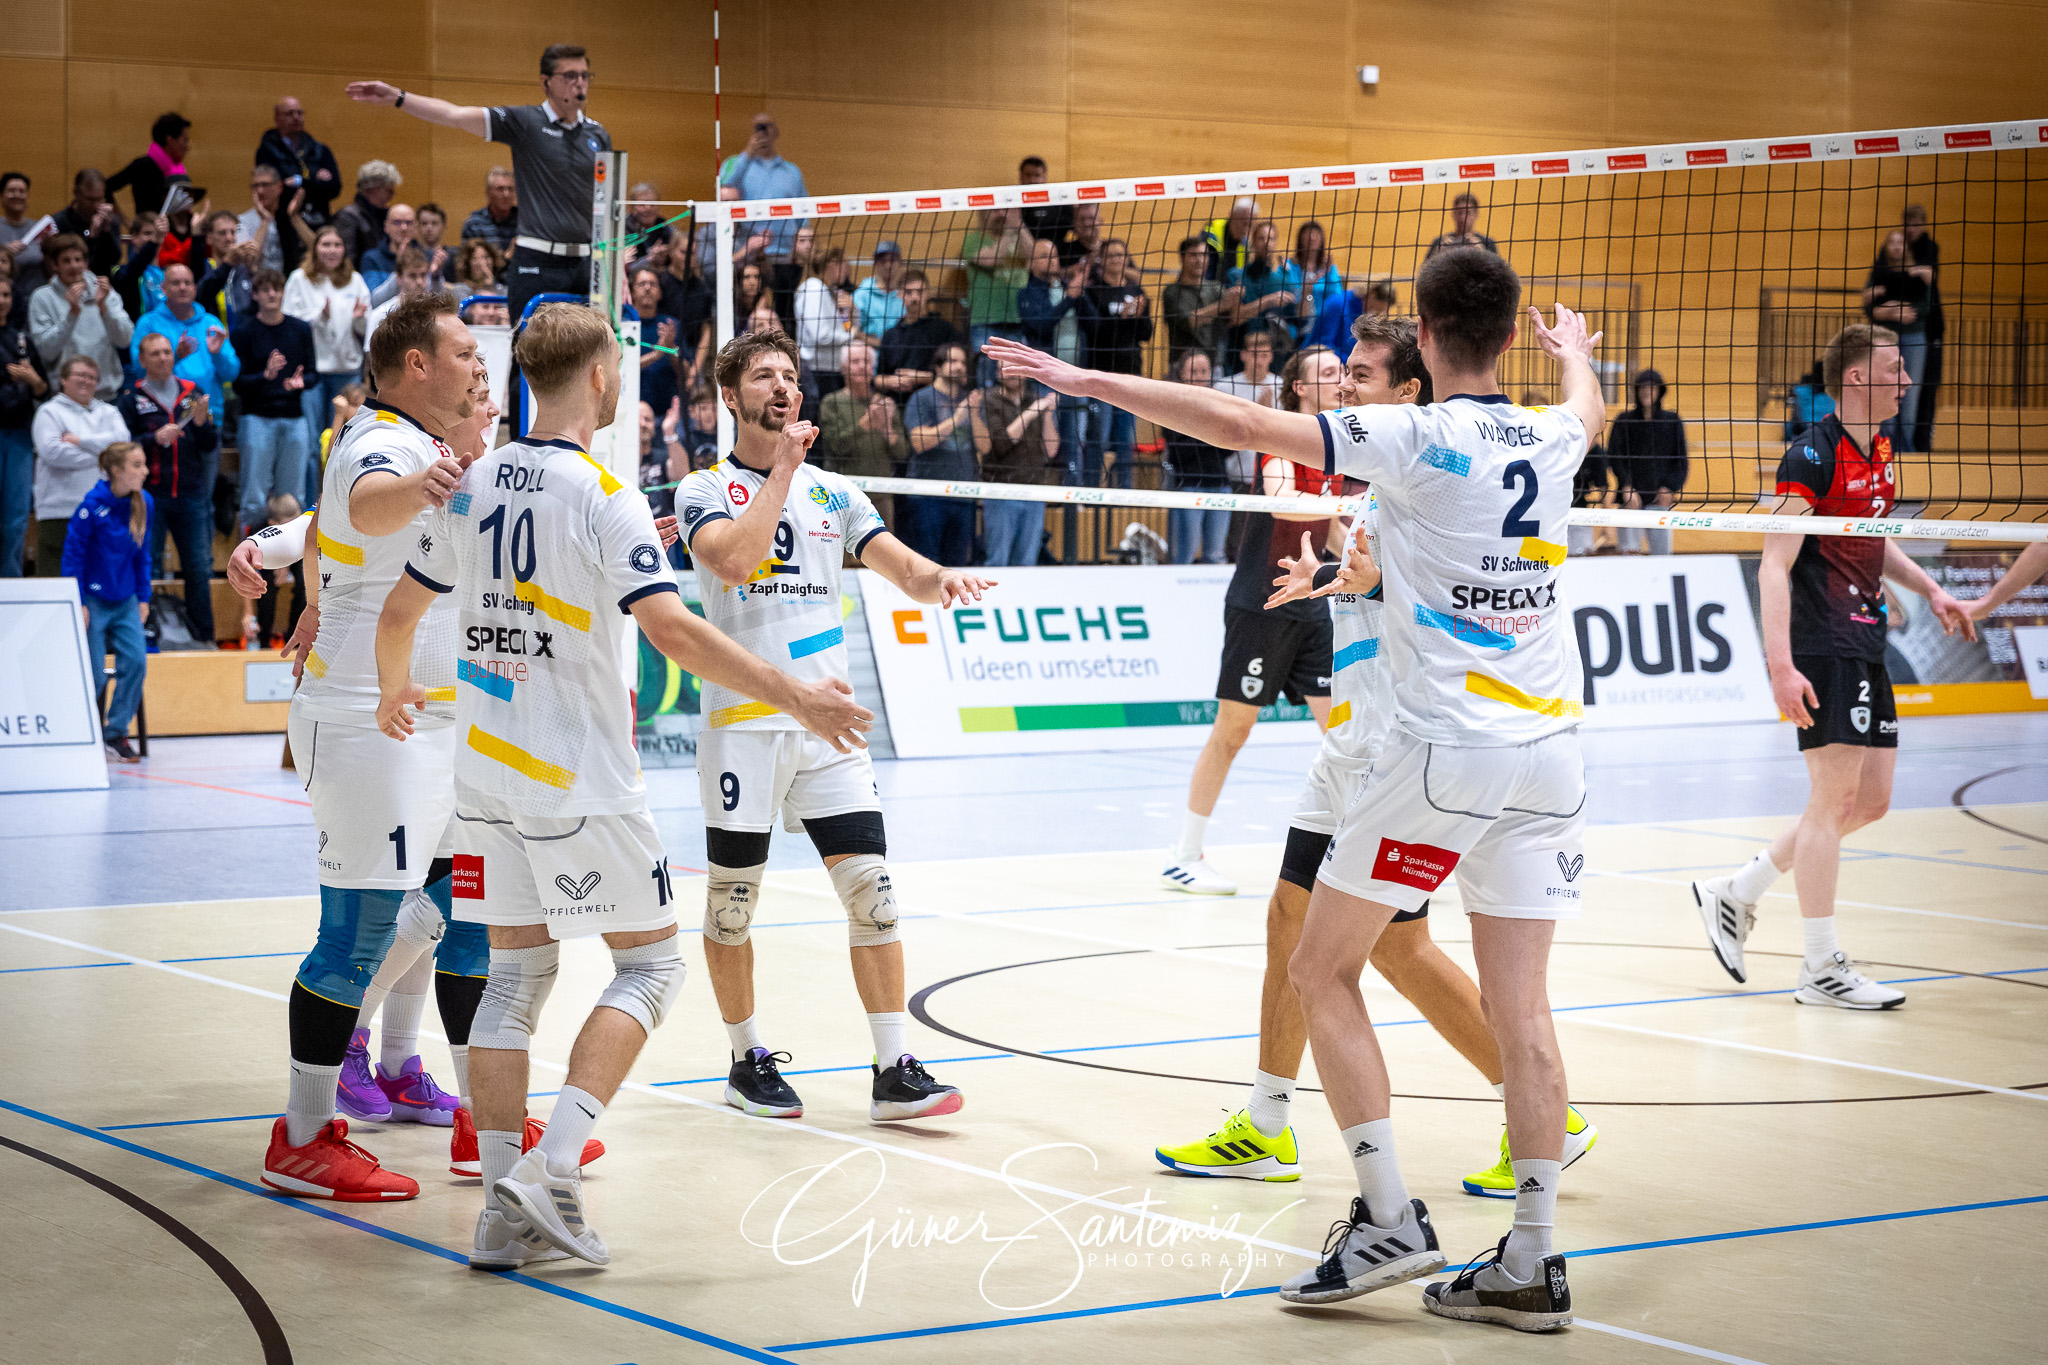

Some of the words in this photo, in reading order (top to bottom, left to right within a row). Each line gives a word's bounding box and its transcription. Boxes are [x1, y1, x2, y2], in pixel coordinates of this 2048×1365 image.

[1474, 420, 1543, 448] WACEK
[495, 463, 545, 493] ROLL
[1205, 498, 1237, 508] FUCHS
[1502, 459, 1541, 538] 2
[1670, 516, 1713, 527] FUCHS
[1856, 523, 1903, 534] FUCHS
[1911, 525, 1939, 536] Ideen
[1940, 528, 1989, 538] umsetzen
[479, 504, 537, 583] 10
[774, 521, 795, 562] 9
[1481, 555, 1499, 572] SV
[1502, 555, 1550, 573] Schwaig
[482, 592, 499, 609] SV
[749, 582, 779, 597] Zapf
[781, 582, 828, 597] Daigfuss
[953, 606, 1150, 644] FUCHS
[1453, 614, 1540, 639] pumpen
[1574, 575, 1732, 705] puls
[468, 658, 529, 687] pumpe
[962, 655, 1032, 682] Ideen
[1040, 657, 1159, 681] umsetzen
[1247, 657, 1263, 676] 6
[1858, 680, 1870, 702] 2
[719, 771, 740, 812] 9
[388, 825, 407, 871] 1
[1401, 866, 1439, 884] Nürnberg
[1404, 855, 1445, 872] Sparkasse
[542, 904, 617, 916] OFFICEWELT
[1550, 1266, 1562, 1299] adidas
